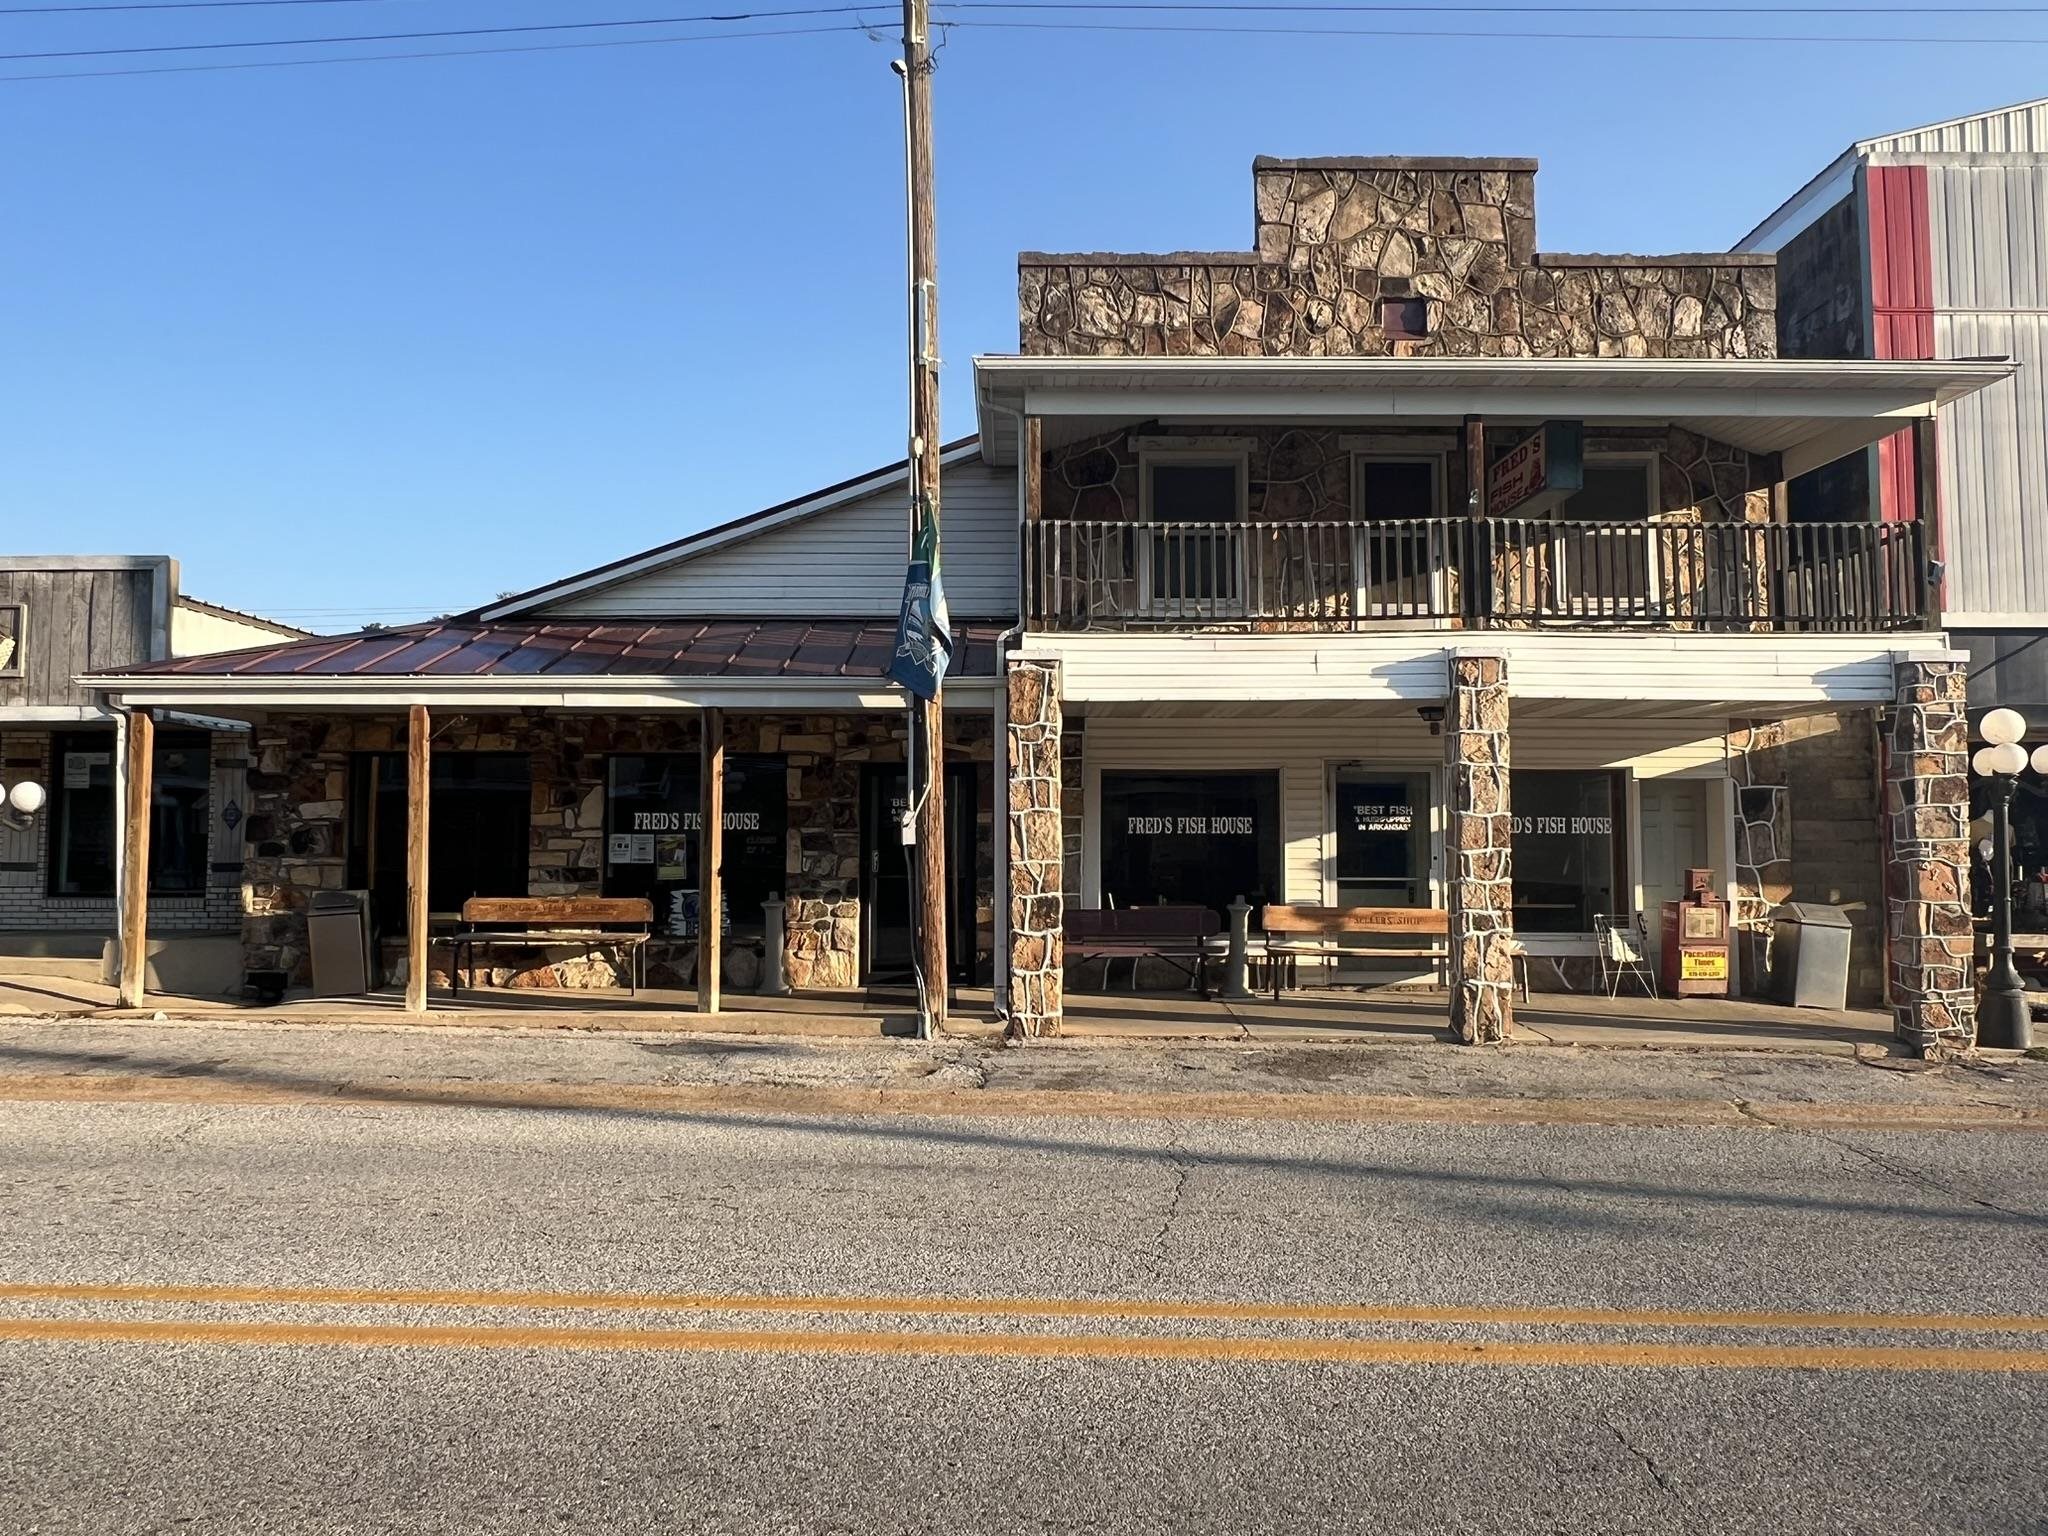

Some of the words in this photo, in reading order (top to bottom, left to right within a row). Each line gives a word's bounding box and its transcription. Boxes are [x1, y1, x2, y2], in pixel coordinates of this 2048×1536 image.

[1493, 435, 1541, 482] FRED'S
[1491, 472, 1523, 502] FISH
[1490, 486, 1524, 515] HOUSE
[1389, 805, 1413, 815] FISH
[634, 812, 679, 830] FRED'S
[683, 812, 701, 830] FIS
[1127, 816, 1173, 834] FRED'S
[1177, 816, 1207, 834] FISH
[1210, 816, 1253, 834] HOUSE
[1510, 816, 1532, 834] D'S
[1537, 816, 1566, 834] FISH
[1571, 816, 1612, 834] HOUSE
